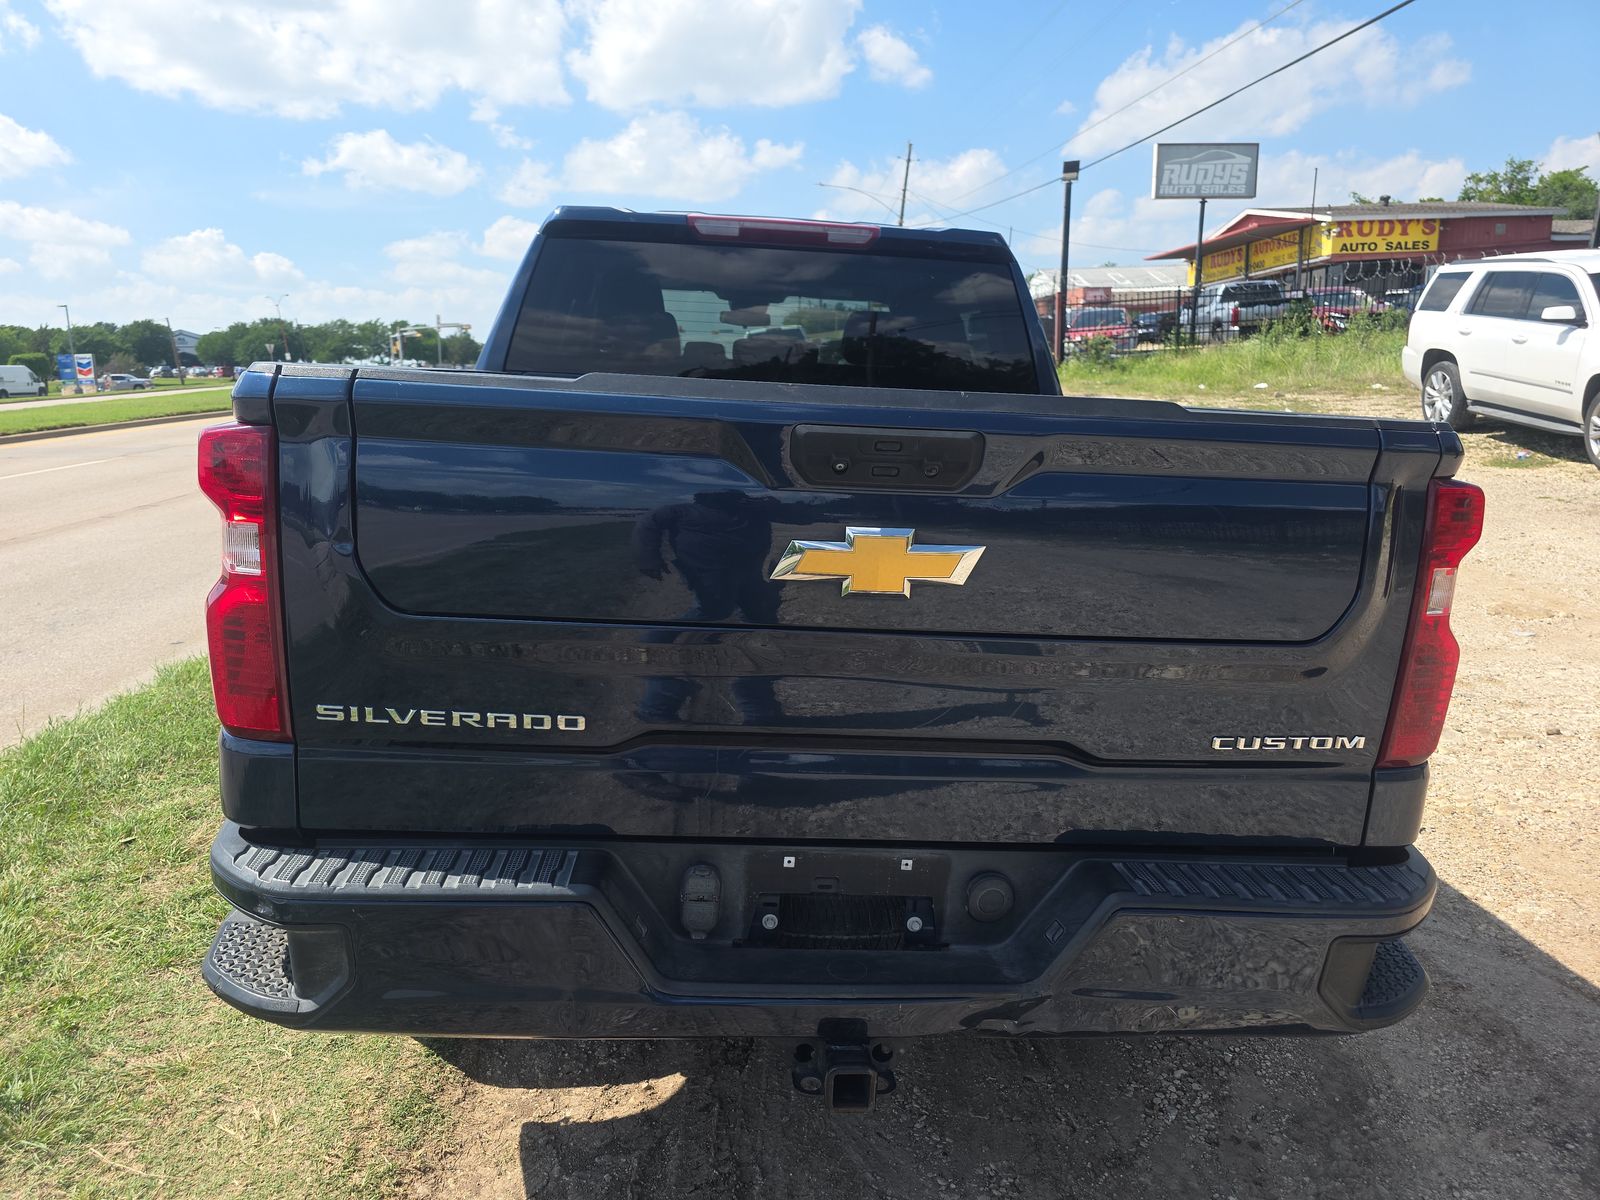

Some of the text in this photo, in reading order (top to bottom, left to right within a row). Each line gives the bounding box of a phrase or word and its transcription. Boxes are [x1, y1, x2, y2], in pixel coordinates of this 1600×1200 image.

[1159, 184, 1246, 195] AUTO SALES
[1335, 219, 1437, 238] RUDY'S
[1339, 240, 1430, 253] AUTO SALES
[315, 703, 587, 732] SILVERADO
[1211, 735, 1366, 750] CUSTOM
